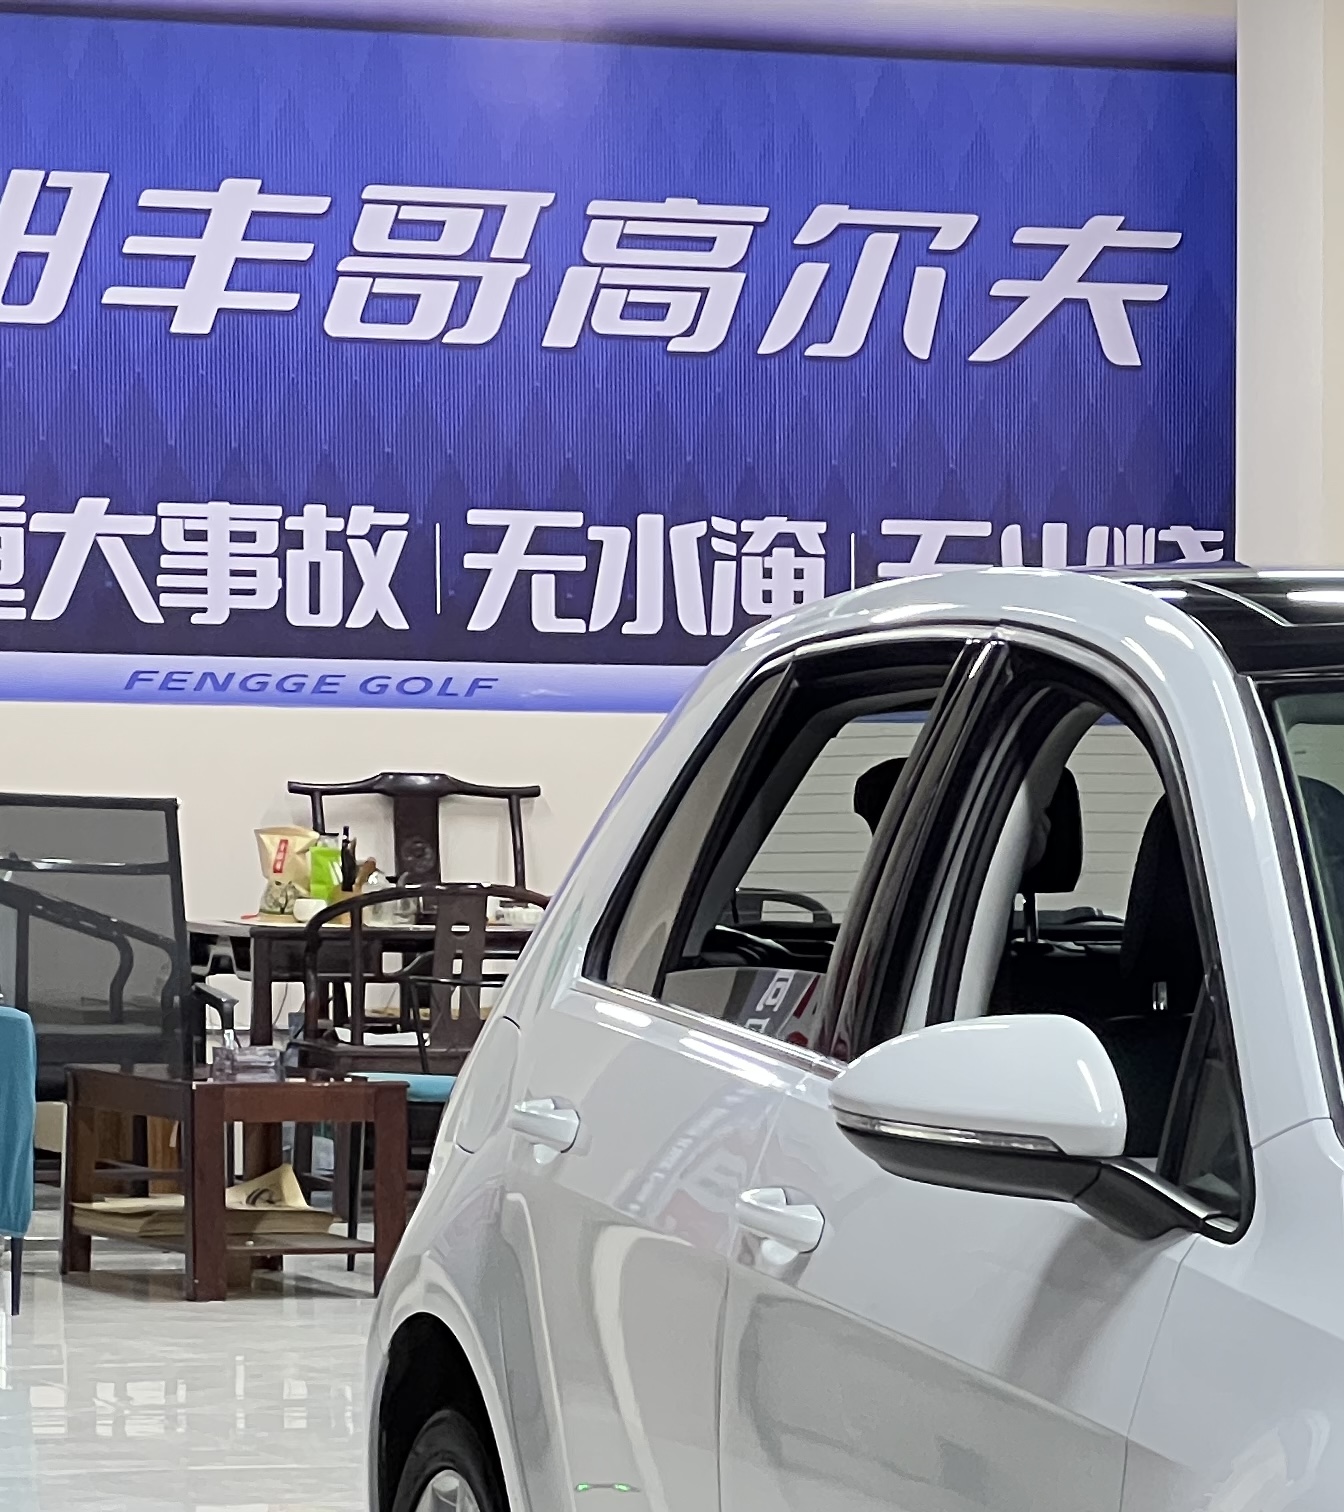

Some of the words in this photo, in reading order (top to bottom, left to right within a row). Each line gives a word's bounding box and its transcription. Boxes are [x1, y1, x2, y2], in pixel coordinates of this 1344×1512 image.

[0, 494, 410, 631] 大事故
[463, 508, 828, 637] 无水淹
[124, 669, 347, 694] FENGGE
[359, 676, 499, 698] GOLF
